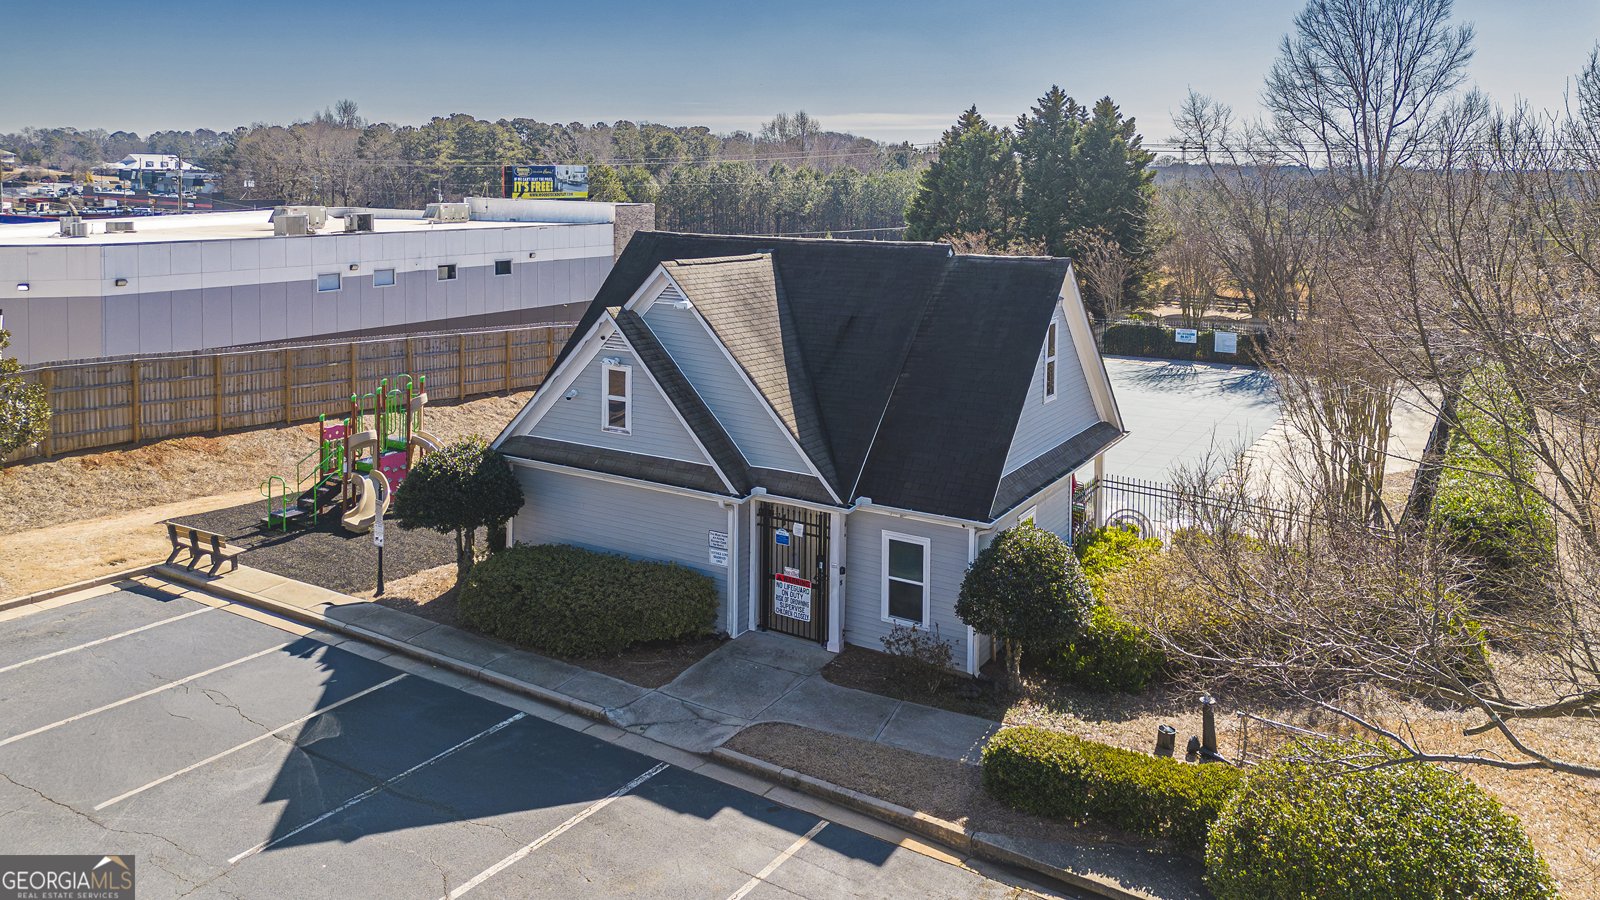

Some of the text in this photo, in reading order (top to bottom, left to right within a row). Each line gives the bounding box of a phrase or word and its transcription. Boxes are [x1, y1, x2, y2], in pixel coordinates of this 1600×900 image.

[514, 181, 553, 192] IT'S FREE!
[782, 589, 804, 600] ON DUTY
[784, 583, 810, 595] LIFEGUARD
[780, 601, 805, 613] SUPERVISE
[776, 607, 809, 620] CHILDREN CLOSELY
